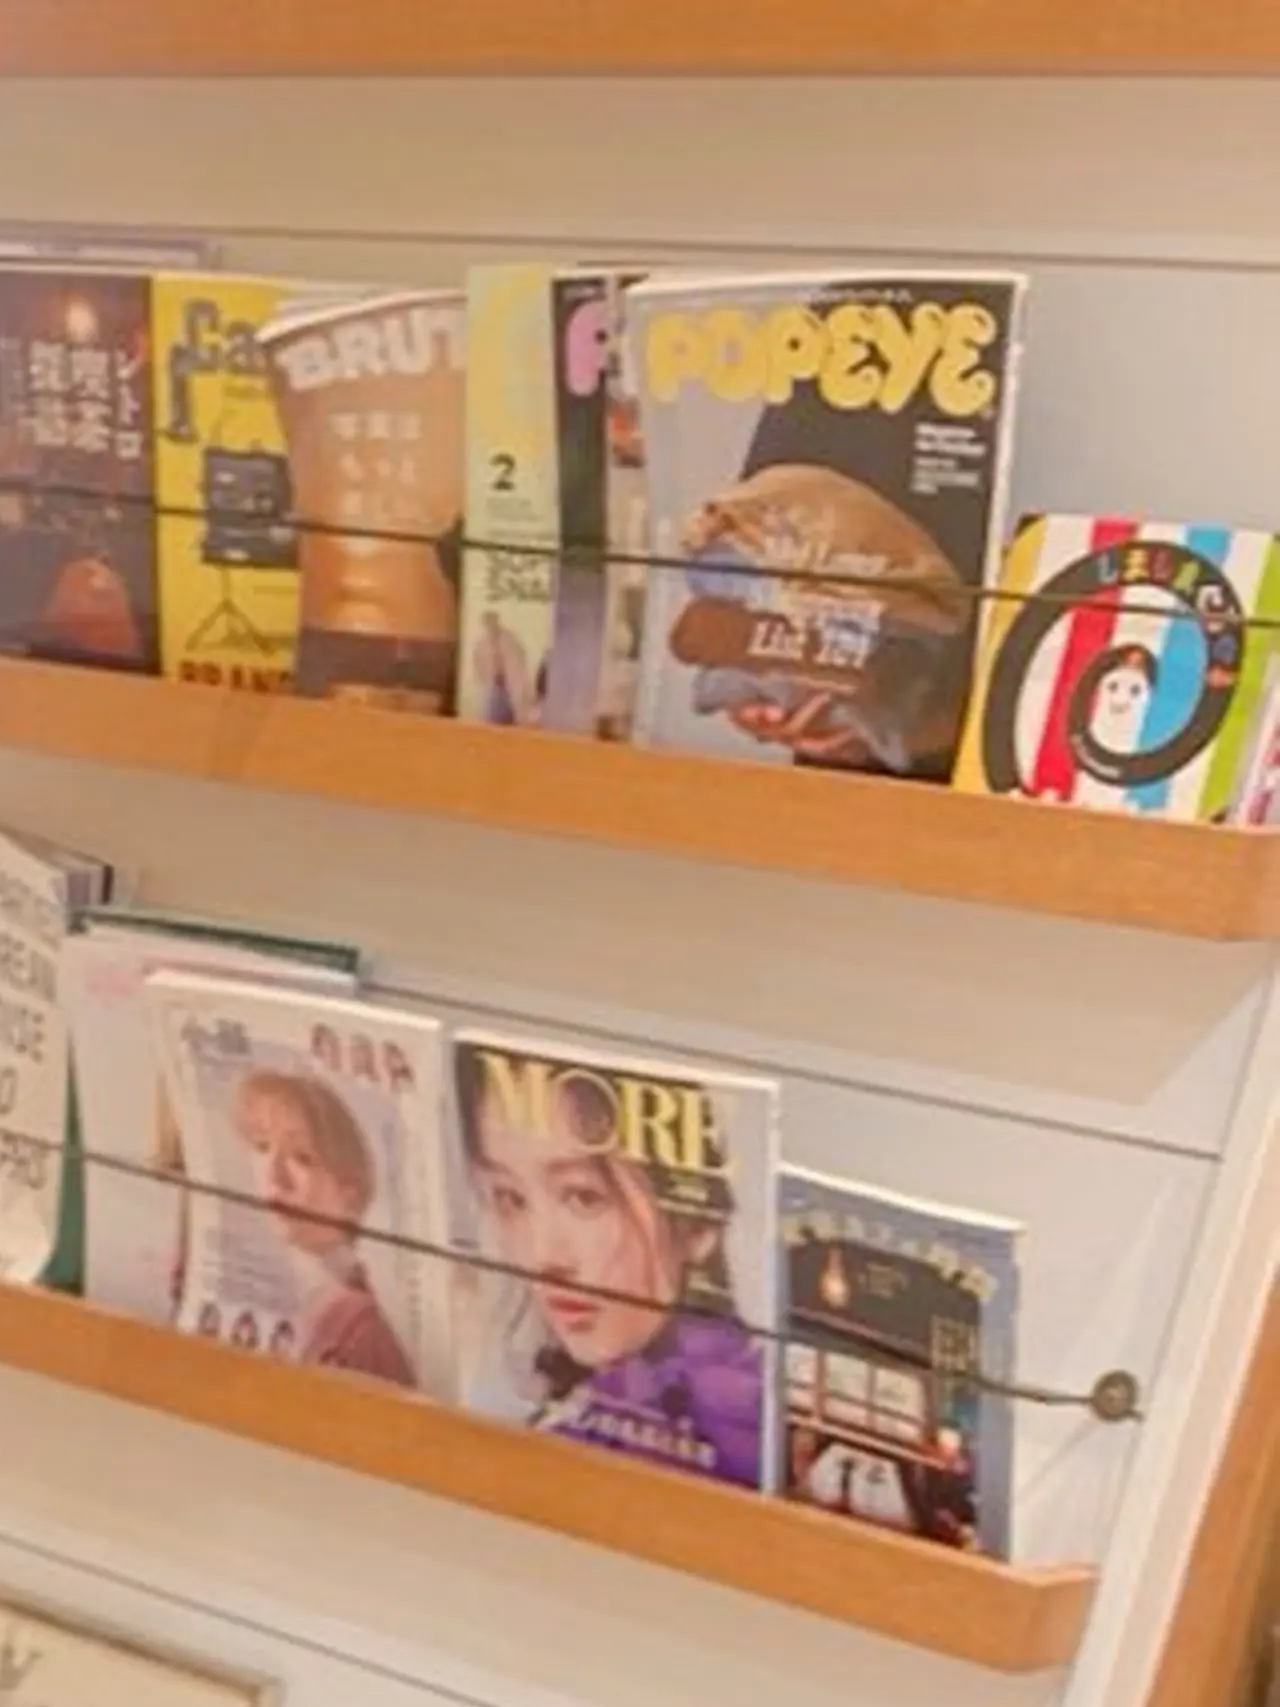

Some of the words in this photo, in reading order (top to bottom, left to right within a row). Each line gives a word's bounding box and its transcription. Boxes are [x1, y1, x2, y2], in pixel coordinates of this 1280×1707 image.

[646, 302, 998, 417] POPEYE
[489, 453, 516, 491] 2
[474, 1051, 739, 1177] MORE
